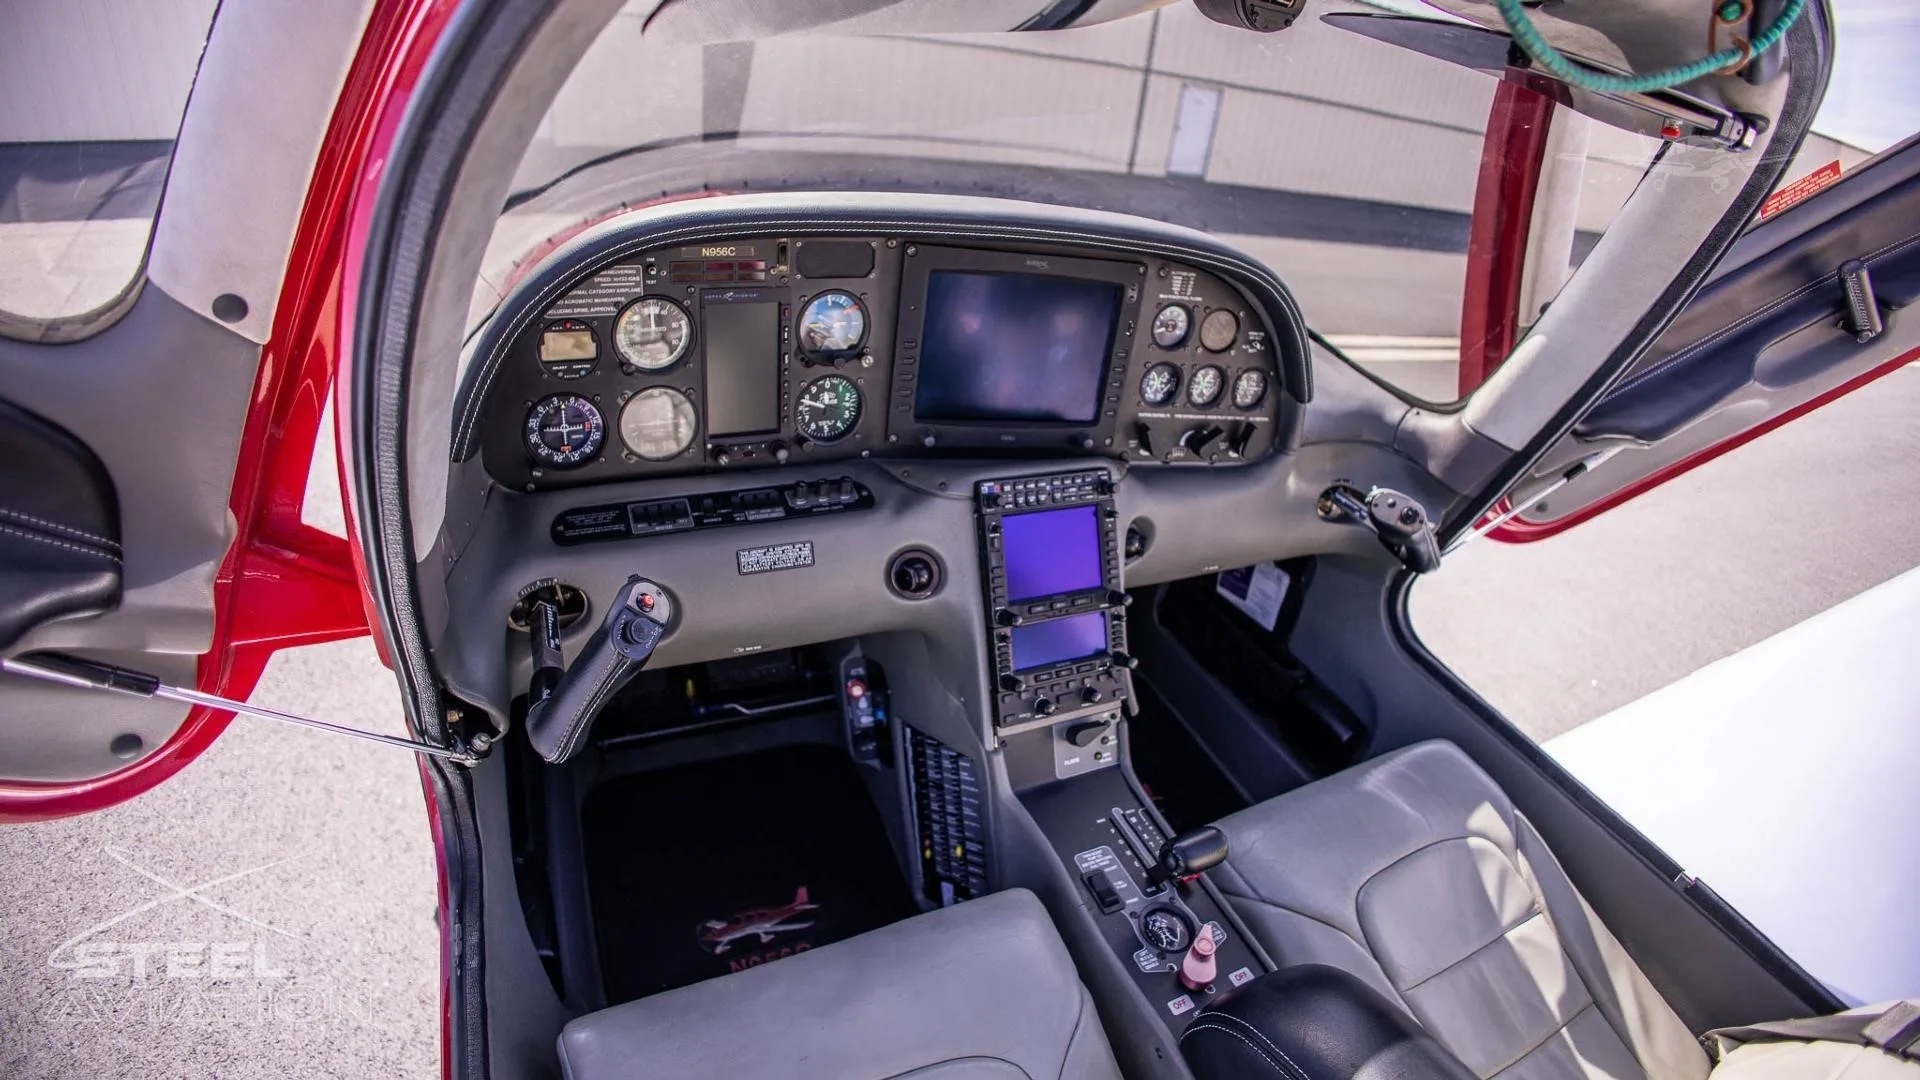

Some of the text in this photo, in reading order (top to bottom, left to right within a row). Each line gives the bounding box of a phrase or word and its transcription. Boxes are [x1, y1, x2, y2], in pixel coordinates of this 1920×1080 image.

[702, 247, 736, 257] N956C
[1234, 970, 1249, 981] OFF
[1172, 998, 1187, 1010] OFF
